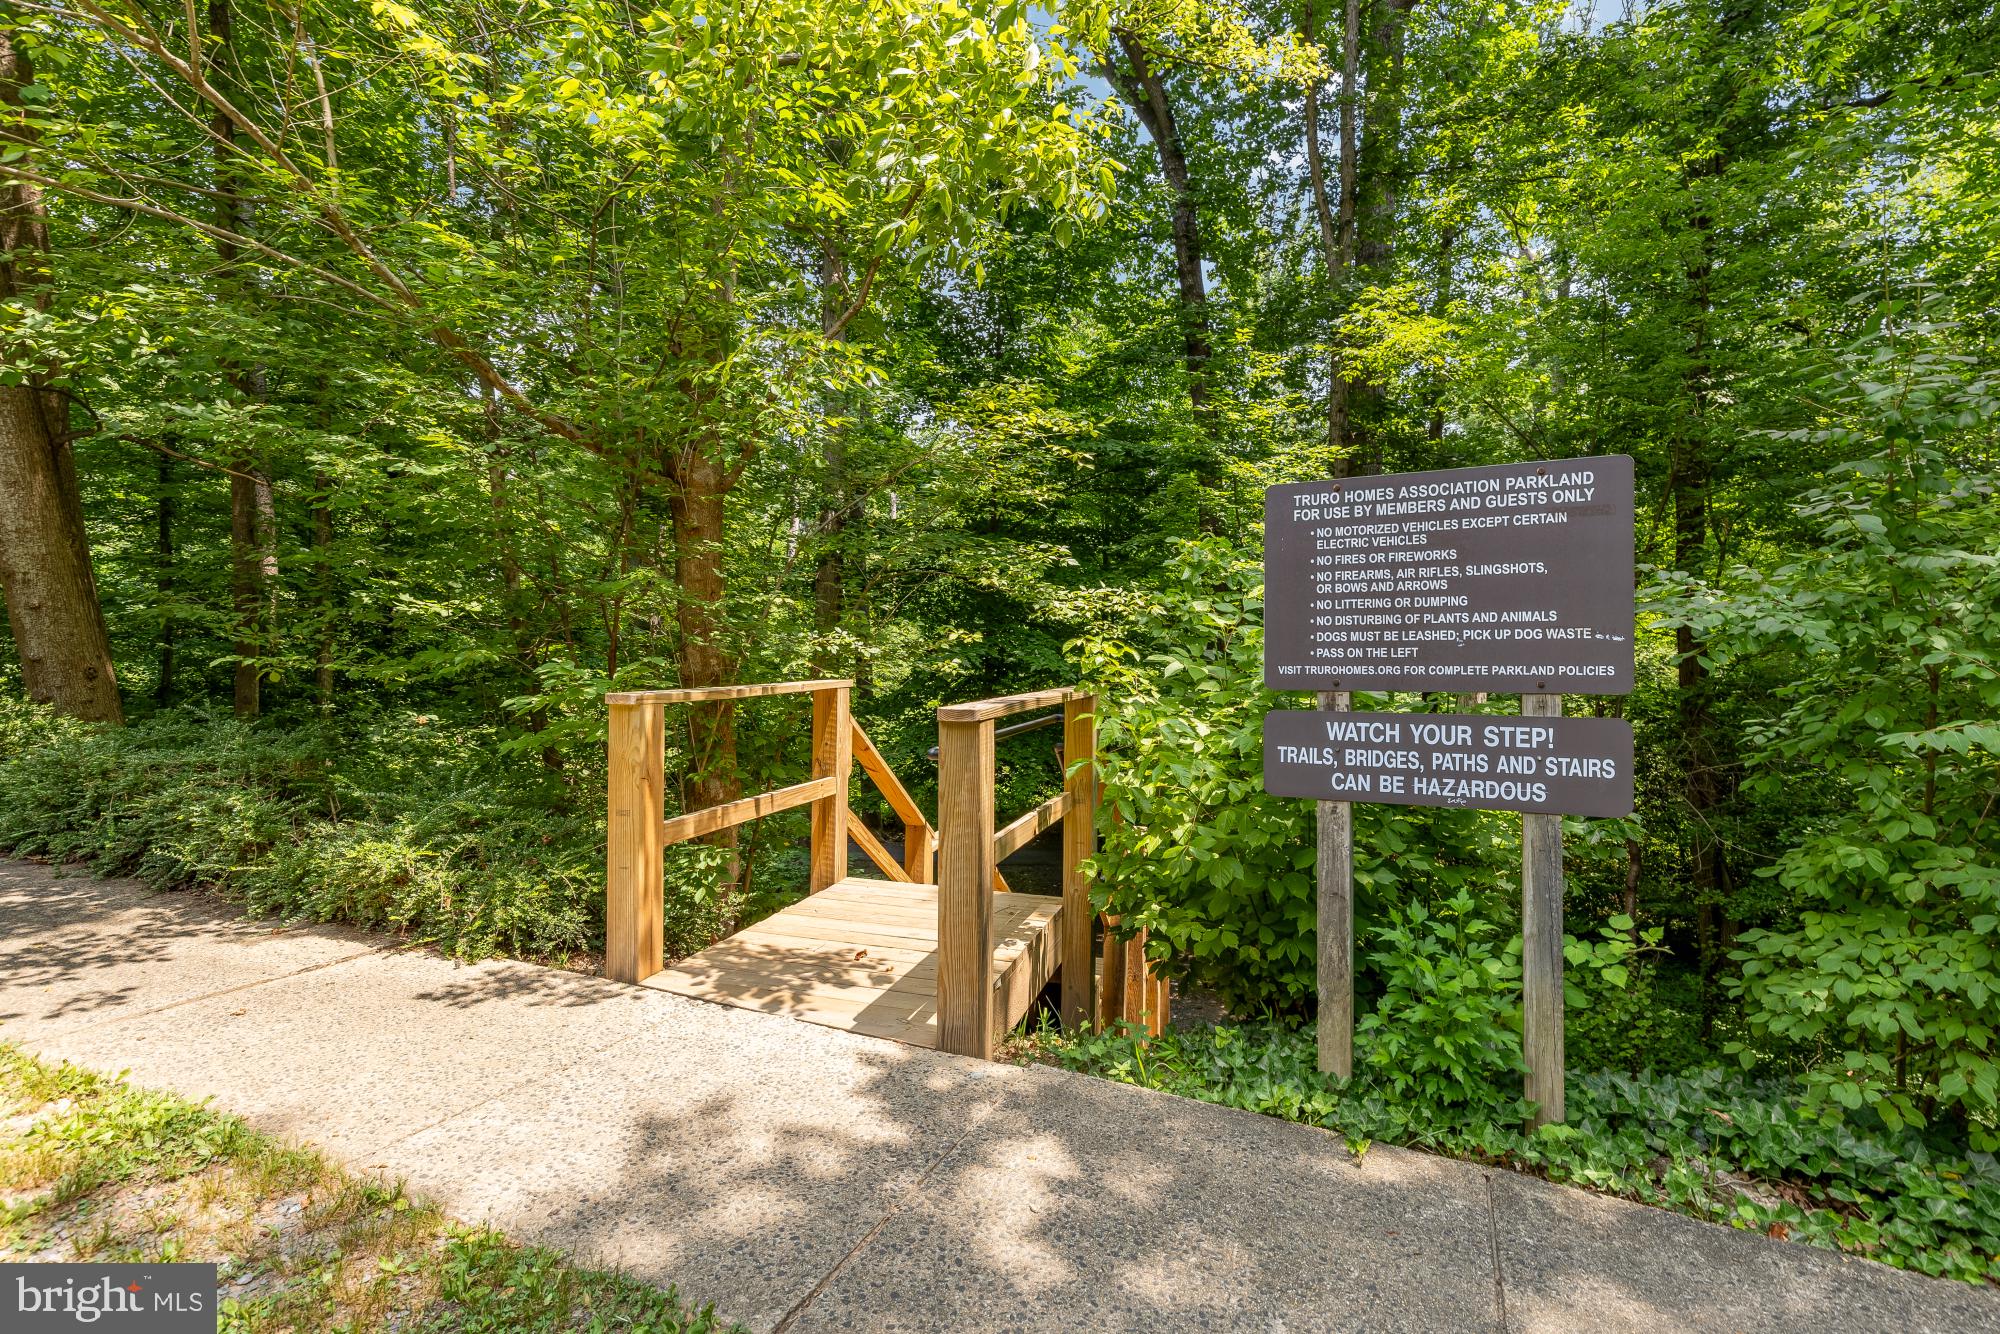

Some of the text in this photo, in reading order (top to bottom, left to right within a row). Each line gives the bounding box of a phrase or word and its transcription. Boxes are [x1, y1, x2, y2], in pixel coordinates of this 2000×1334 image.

[1294, 472, 1594, 506] TRURO HOMES ASSOCIATION PARKLAND
[1294, 488, 1594, 521] FOR USE BY MEMBERS AND GUESTS ONLY
[1317, 512, 1567, 537] NO MOTORIZED VEHICLES EXCEPT CERTAIN
[1317, 534, 1427, 549] ELECTRIC VEHICLES
[1317, 549, 1457, 565] NO FIRES OR FIREWORKS
[1317, 562, 1547, 581] NO FIREARMS, AIR RIFLES, SLINGSHOTS,
[1317, 580, 1447, 593] OR BOWS AND ARROWS
[1317, 596, 1468, 609] NO LITTERING OR DUMPING
[1317, 611, 1557, 625] NO DISTURBING OF PLANTS AND ANIMALS
[1317, 632, 1347, 641] DOGS
[1351, 632, 1380, 641] MUST
[1384, 631, 1399, 641] BE
[1463, 630, 1491, 640] PICK
[1495, 629, 1511, 639] UP
[1515, 629, 1542, 639] DOG
[1546, 628, 1591, 639] WASTE
[1317, 648, 1418, 657] PASS ON THE LEFT
[1278, 665, 1615, 675] VISIT TRUROHOMES.ORG FOR COMPLETE PARKLAND POLICIES
[1326, 722, 1554, 748] WATCH YOUR STEP!
[1278, 746, 1615, 779] TRAILS, BRIDGES, PATHS AND STAIRS
[1331, 773, 1370, 792] CAN
[1380, 775, 1404, 794] BE
[1413, 777, 1546, 802] HAZARDOUS
